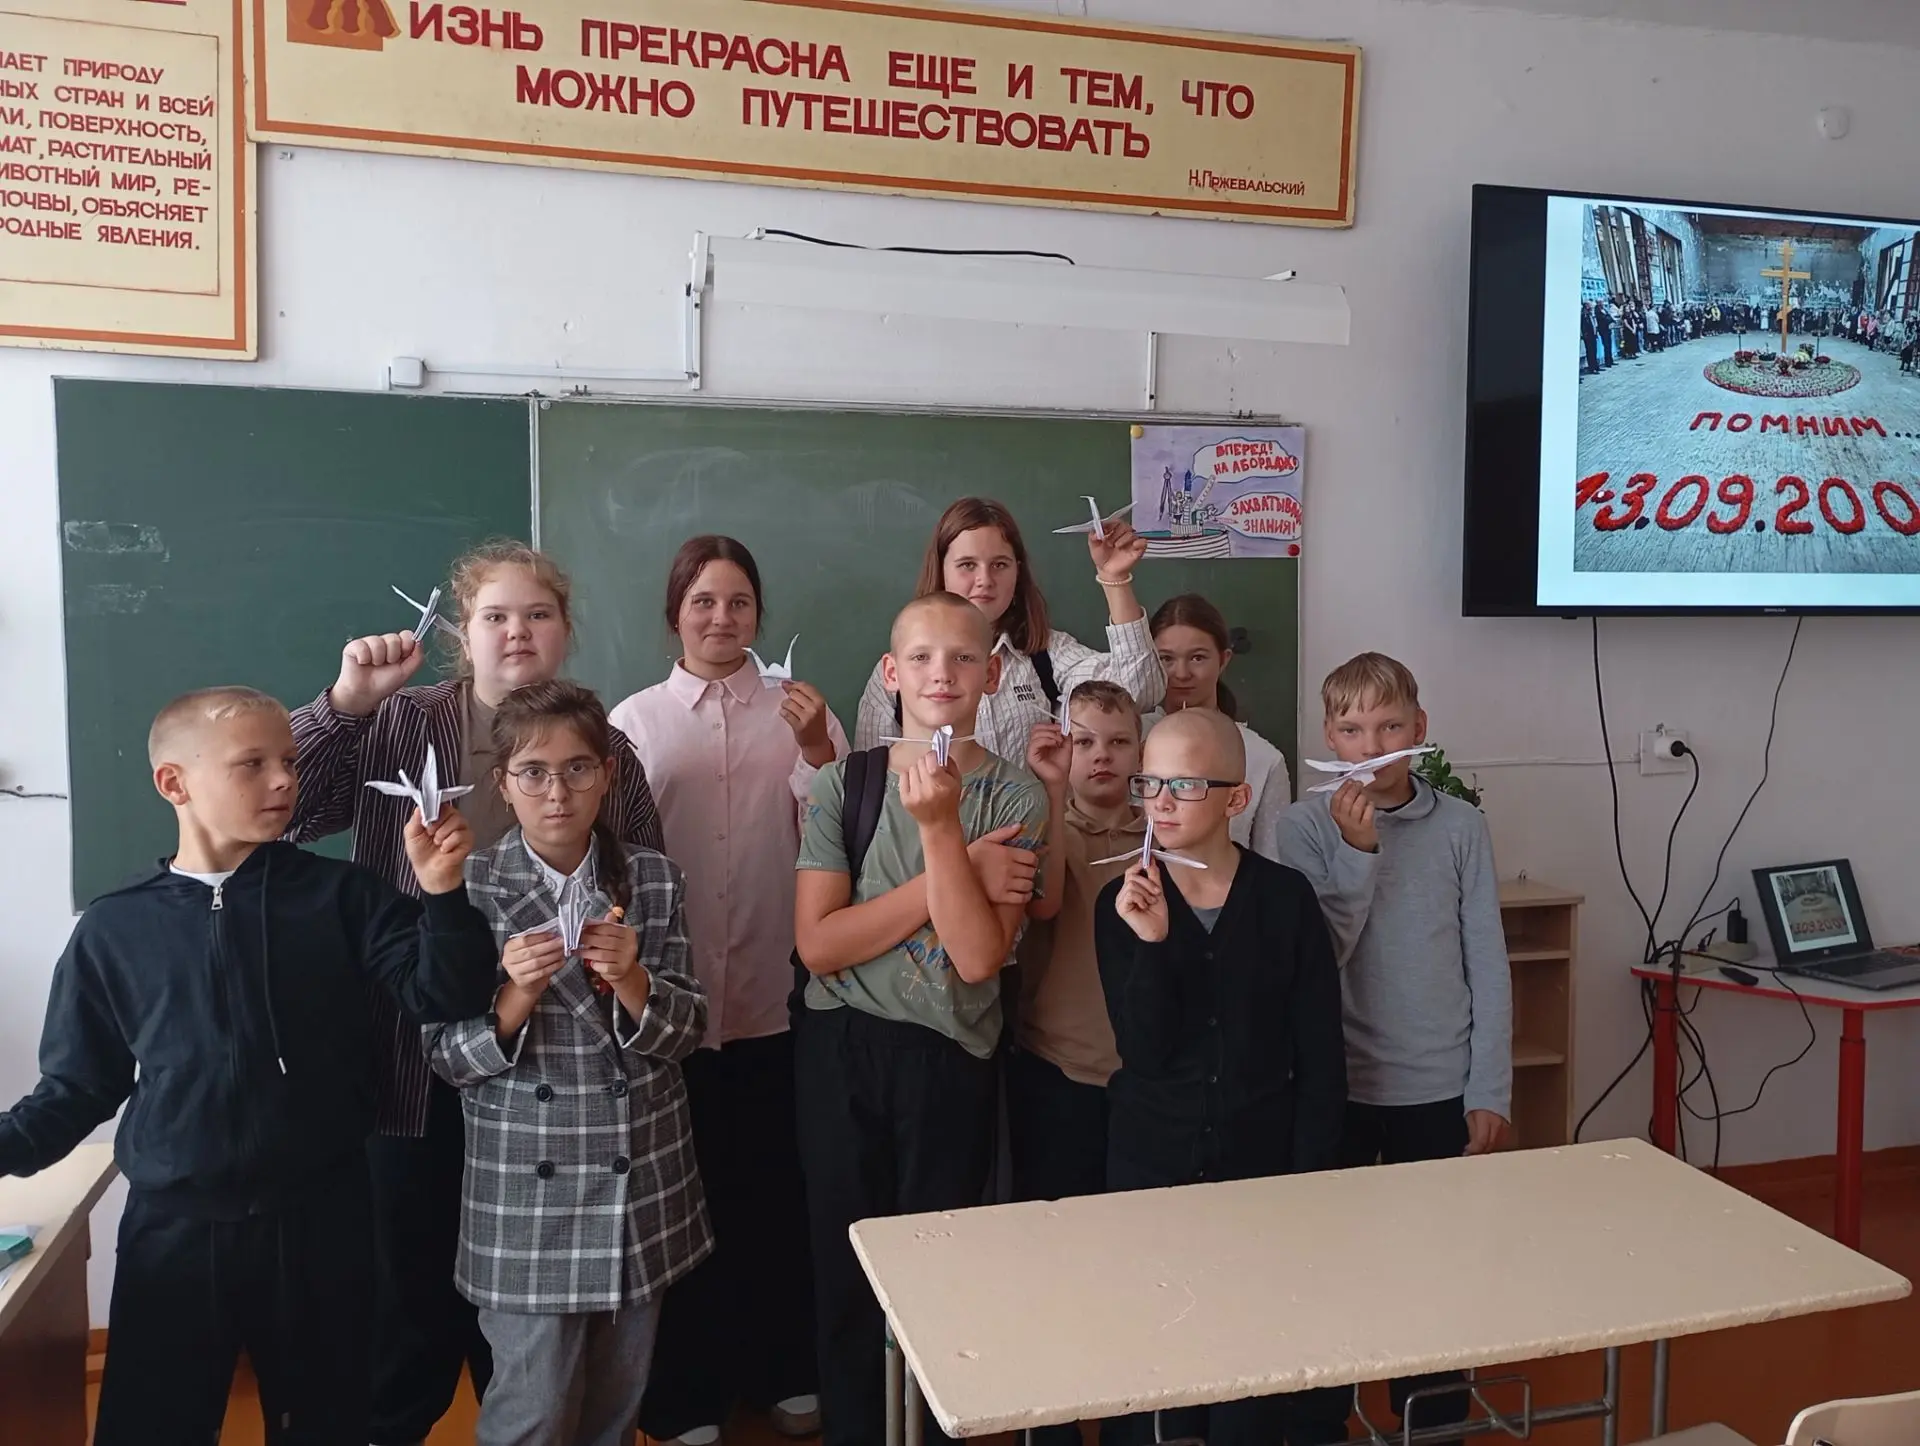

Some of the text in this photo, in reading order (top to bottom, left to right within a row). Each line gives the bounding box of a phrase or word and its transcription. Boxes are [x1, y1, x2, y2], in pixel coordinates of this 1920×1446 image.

[63, 57, 164, 84] ПРИРОДУ
[581, 18, 850, 83] ПРЕКРАСНА
[888, 50, 976, 98] ЕЩЕ
[1008, 63, 1033, 98] И
[1060, 67, 1154, 116] ТЕМ,
[1182, 79, 1255, 120] ЧТО
[54, 85, 124, 108] СТРАН
[136, 93, 149, 111] И
[159, 95, 214, 117] ВСЕЙ
[516, 65, 1150, 159] МОЖНО ПУТЕШЕСТВОВАТЬ
[39, 110, 207, 146] ПОВЕРХНОСТЬ,
[48, 138, 212, 171] РАСТИТЕЛЬНЫЙ
[111, 172, 161, 196] МИР,
[173, 178, 211, 196] РЕ-
[81, 197, 208, 223] ОБЪЯСНЯЕТ
[97, 225, 200, 250] ЯВЛЕНИЯ.
[1214, 462, 1228, 475] НА
[1243, 518, 1296, 539] ЗНАНИЯ!
